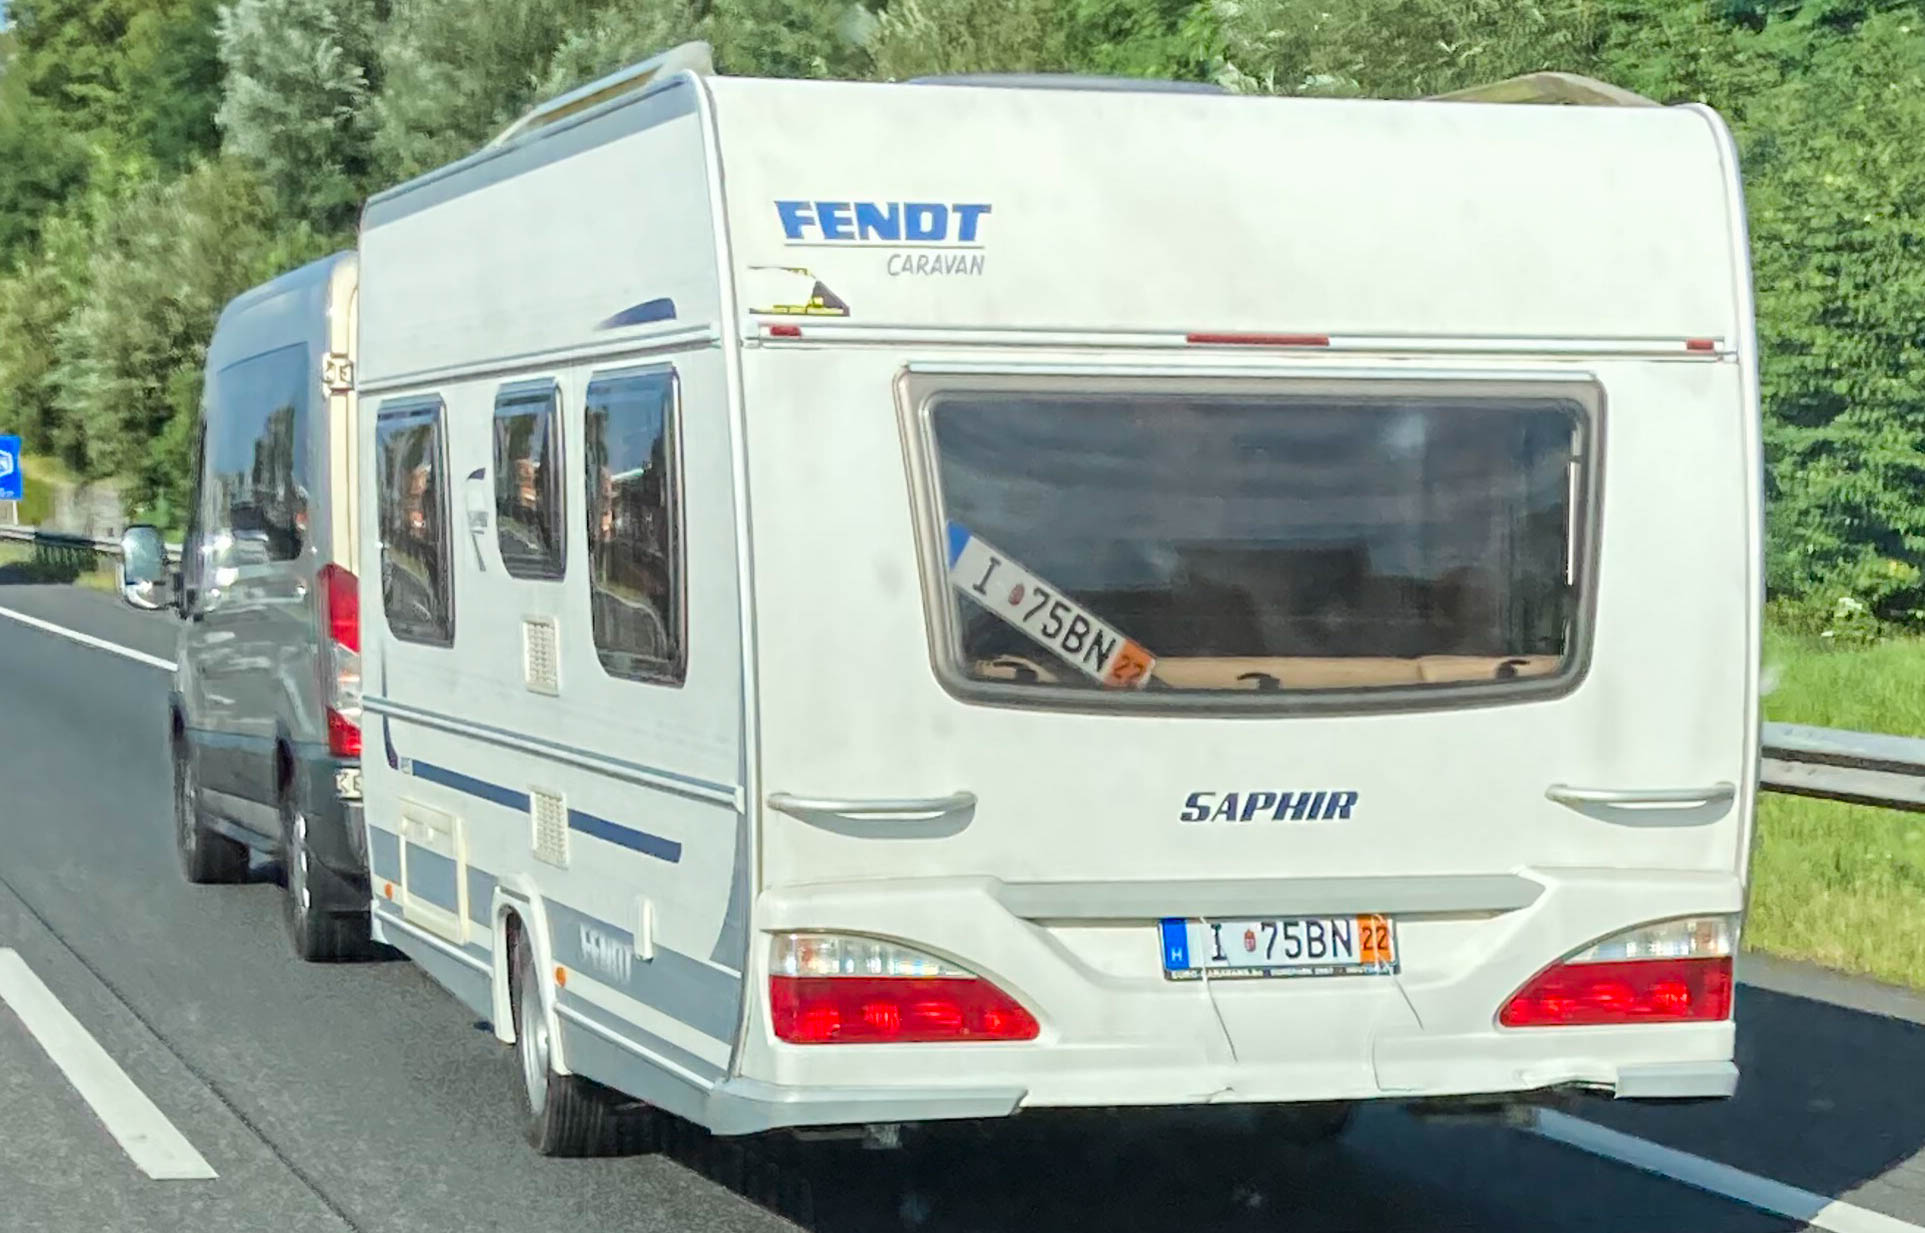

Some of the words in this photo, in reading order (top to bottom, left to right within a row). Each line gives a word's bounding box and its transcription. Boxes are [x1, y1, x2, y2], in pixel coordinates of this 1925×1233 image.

[774, 200, 992, 241] FENDT
[887, 253, 985, 276] CARAVAN
[972, 556, 1001, 595] I
[1022, 586, 1116, 673] 75BN
[1113, 654, 1145, 682] 22
[1180, 791, 1359, 822] SAPHIR
[1171, 948, 1183, 962] H
[1210, 923, 1228, 961] I
[1260, 919, 1353, 960] 75BN
[1361, 926, 1389, 951] 22
